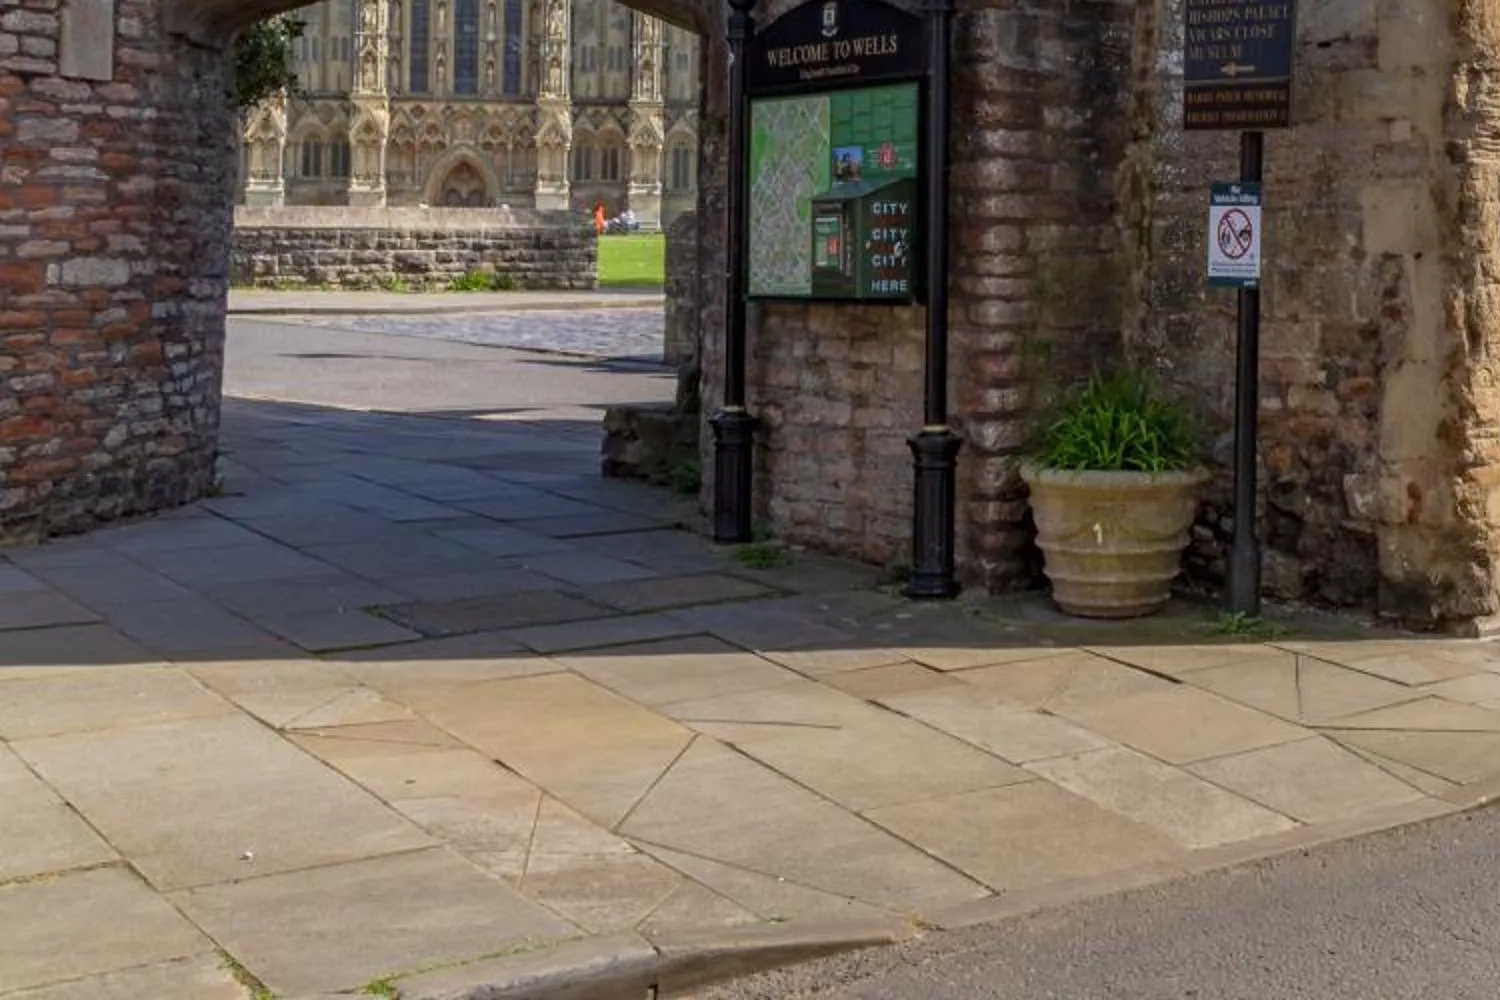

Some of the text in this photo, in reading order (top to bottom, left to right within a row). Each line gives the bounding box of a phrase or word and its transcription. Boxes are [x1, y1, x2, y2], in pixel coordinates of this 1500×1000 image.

[767, 35, 898, 67] WELCOME TO WELLS
[873, 202, 908, 215] CITY
[872, 228, 908, 240] CITY
[871, 279, 909, 293] HERE
